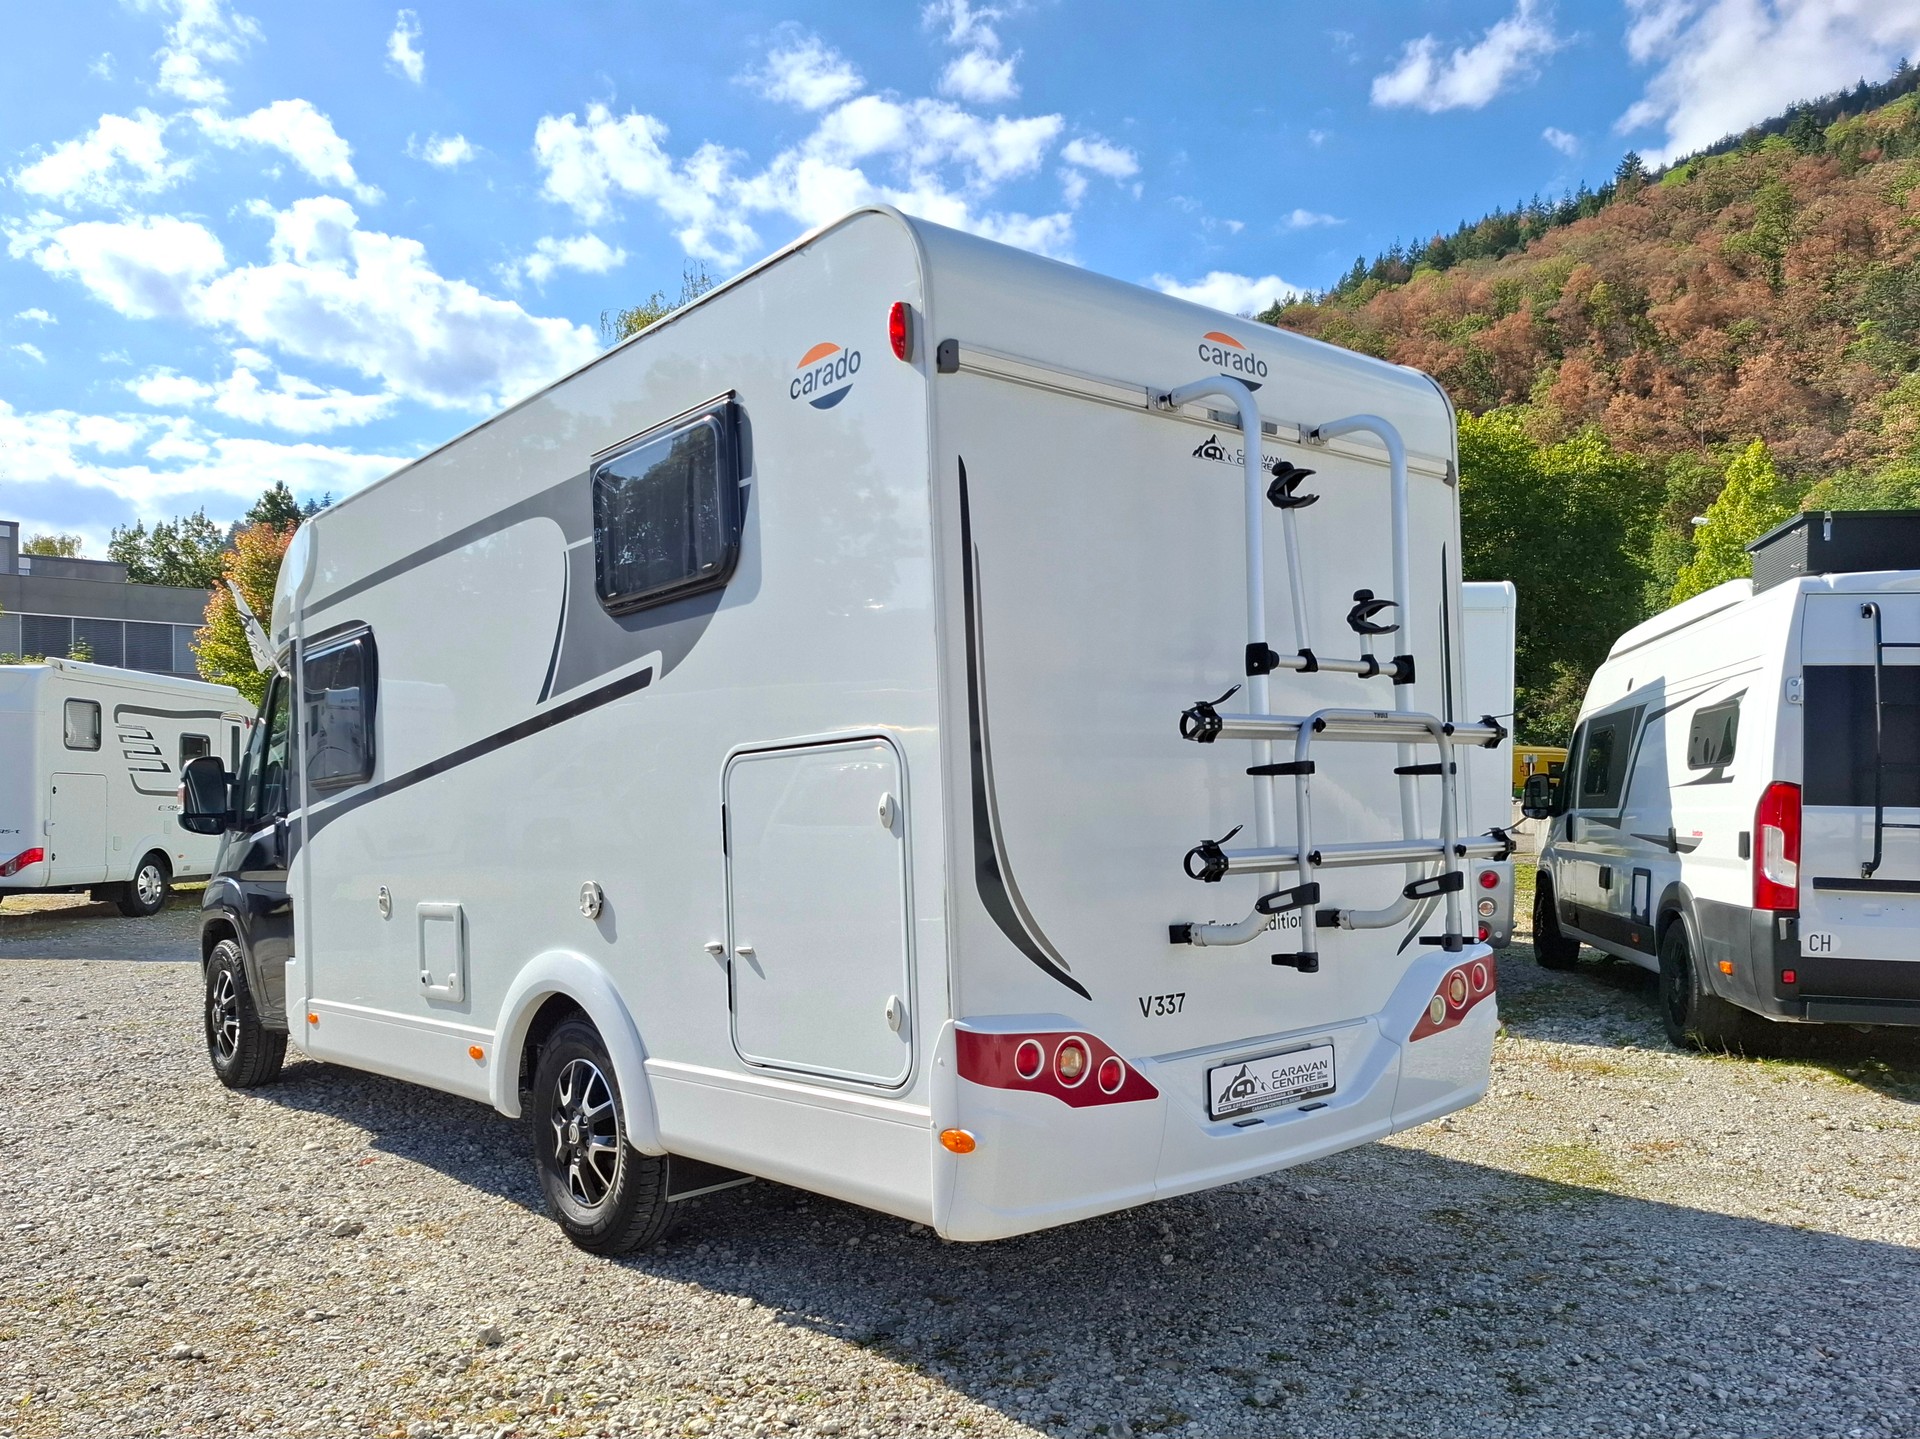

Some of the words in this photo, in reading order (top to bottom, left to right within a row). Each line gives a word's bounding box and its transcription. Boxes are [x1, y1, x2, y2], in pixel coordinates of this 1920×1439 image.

[1198, 343, 1268, 378] carado
[790, 347, 862, 400] carado
[1809, 934, 1831, 952] CH
[1154, 992, 1186, 1017] 337
[1271, 1060, 1328, 1080] CARAVAN
[1272, 1072, 1317, 1090] CENTRE
